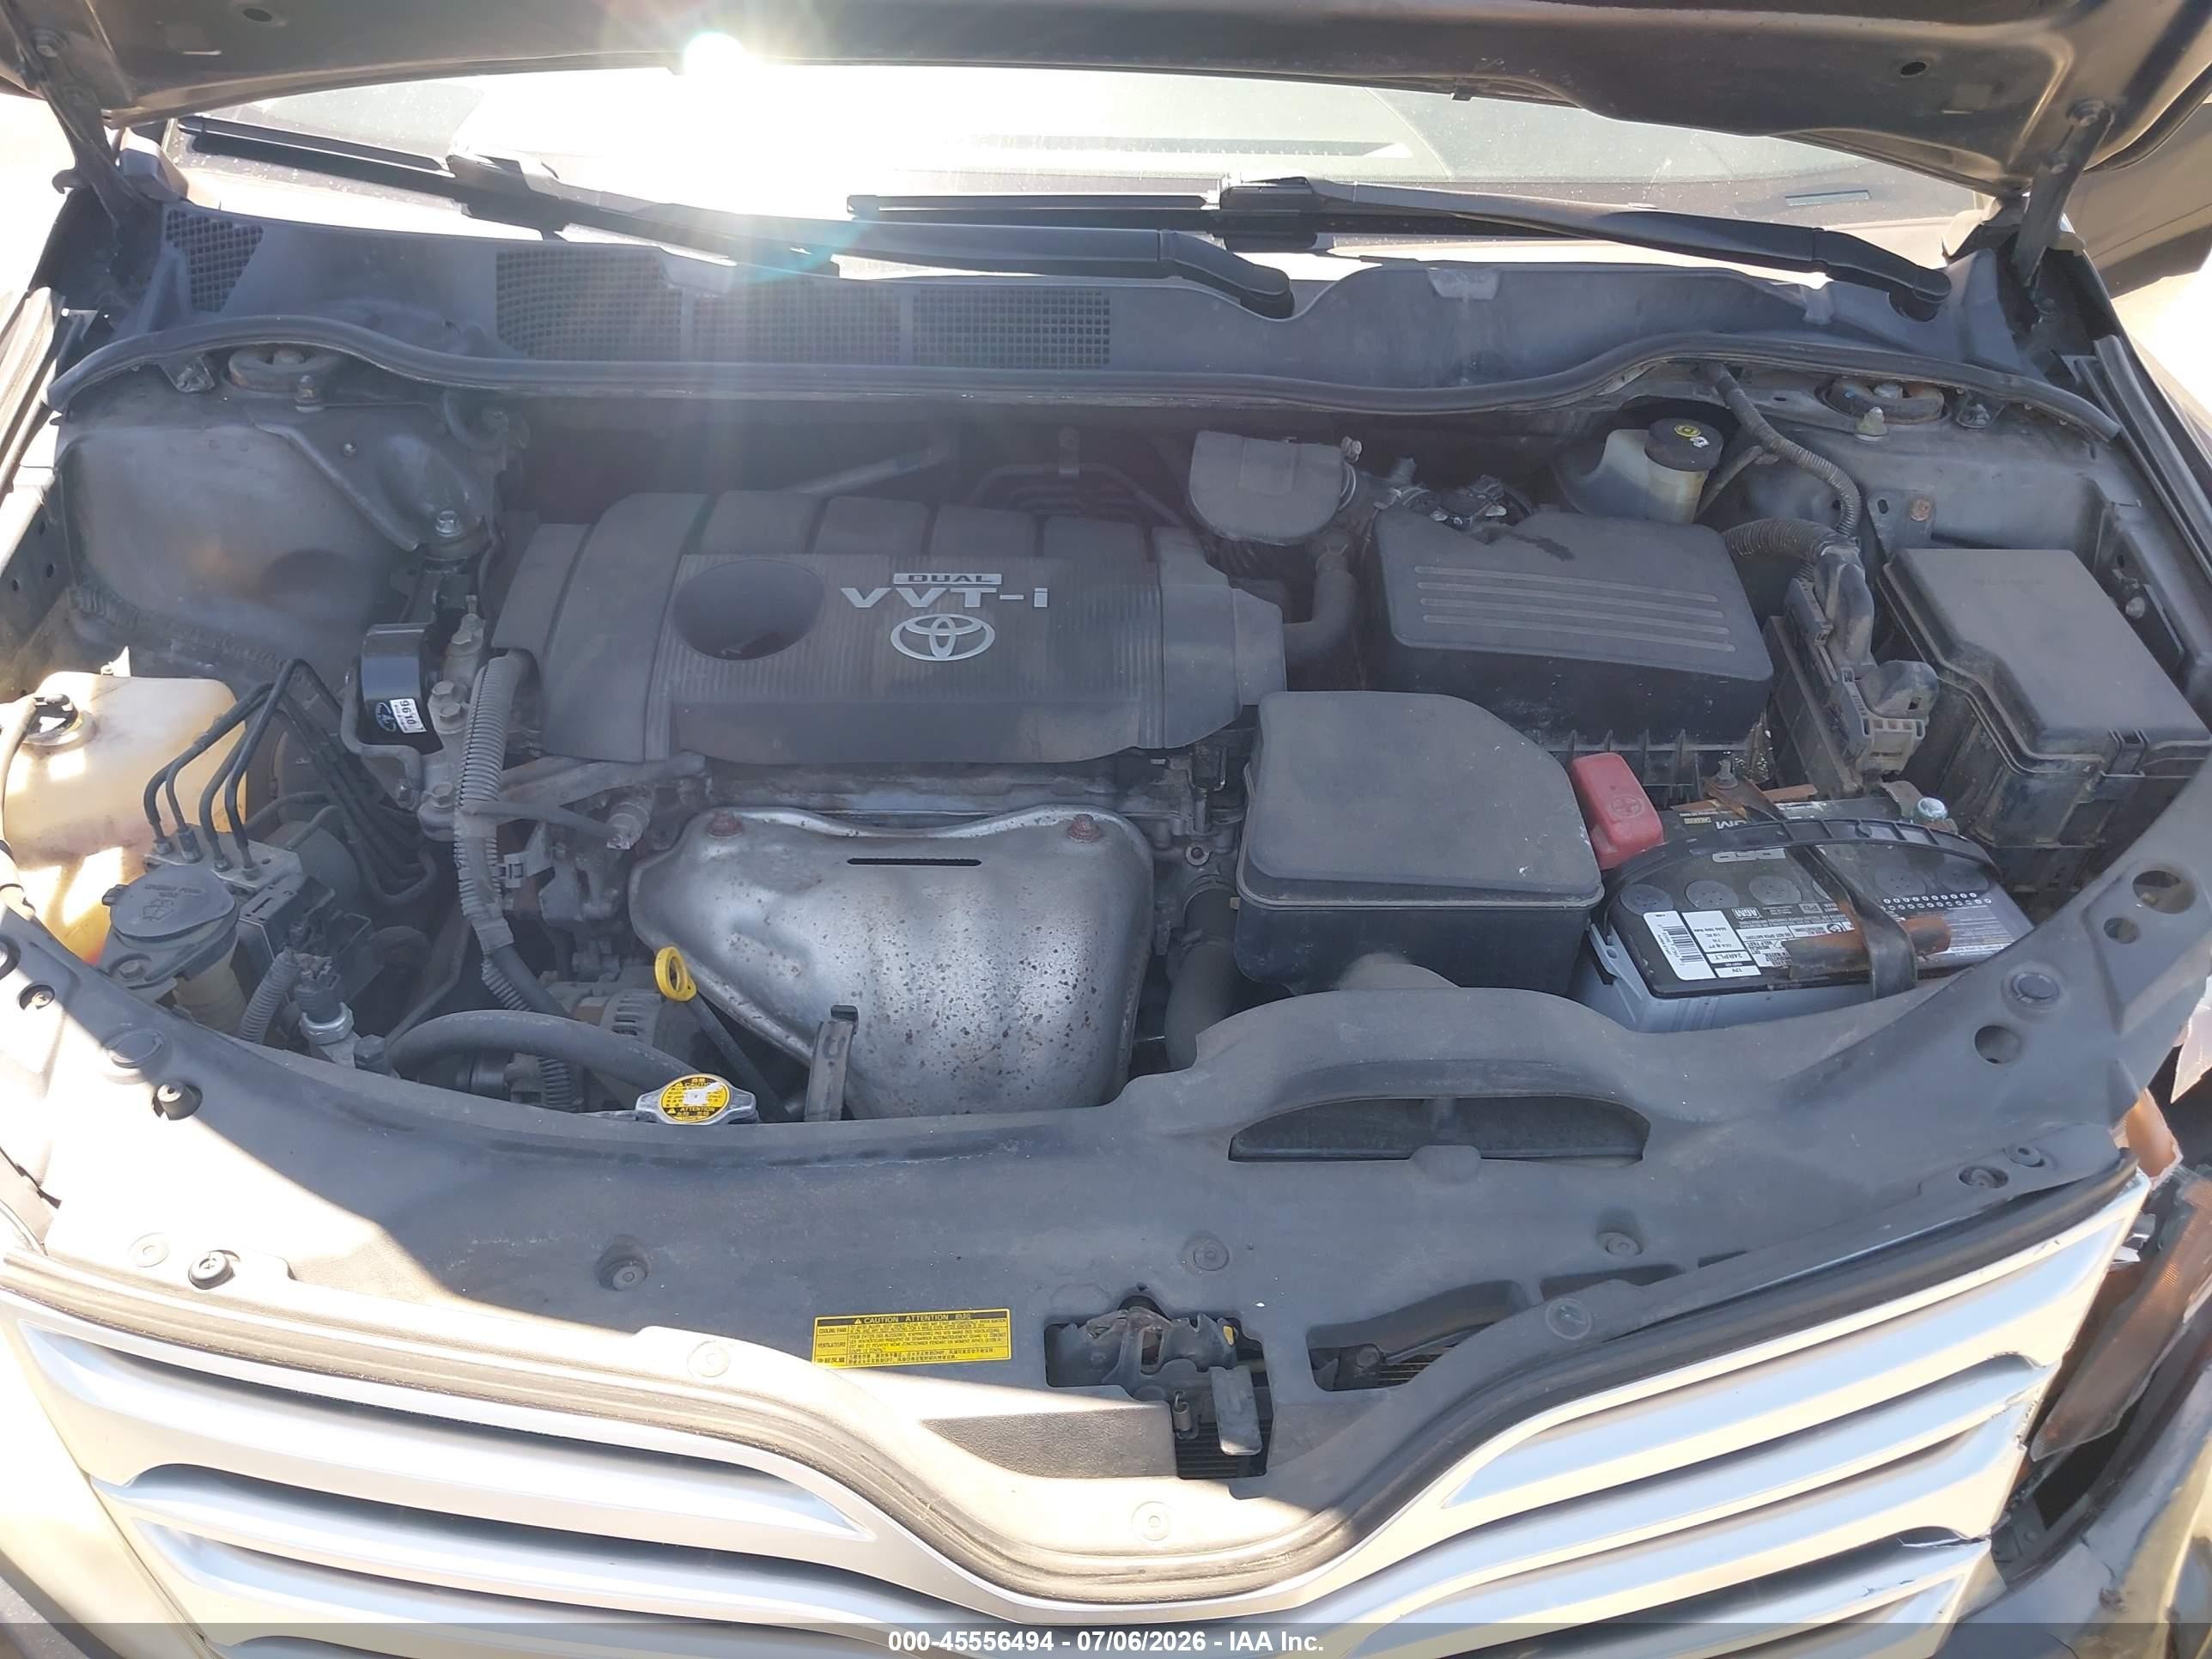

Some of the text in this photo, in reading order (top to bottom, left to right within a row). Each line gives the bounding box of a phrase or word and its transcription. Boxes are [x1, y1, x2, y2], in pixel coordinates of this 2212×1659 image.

[908, 574, 994, 583] DUAL
[840, 587, 1048, 608] VVT-i
[399, 700, 417, 726] 9610
